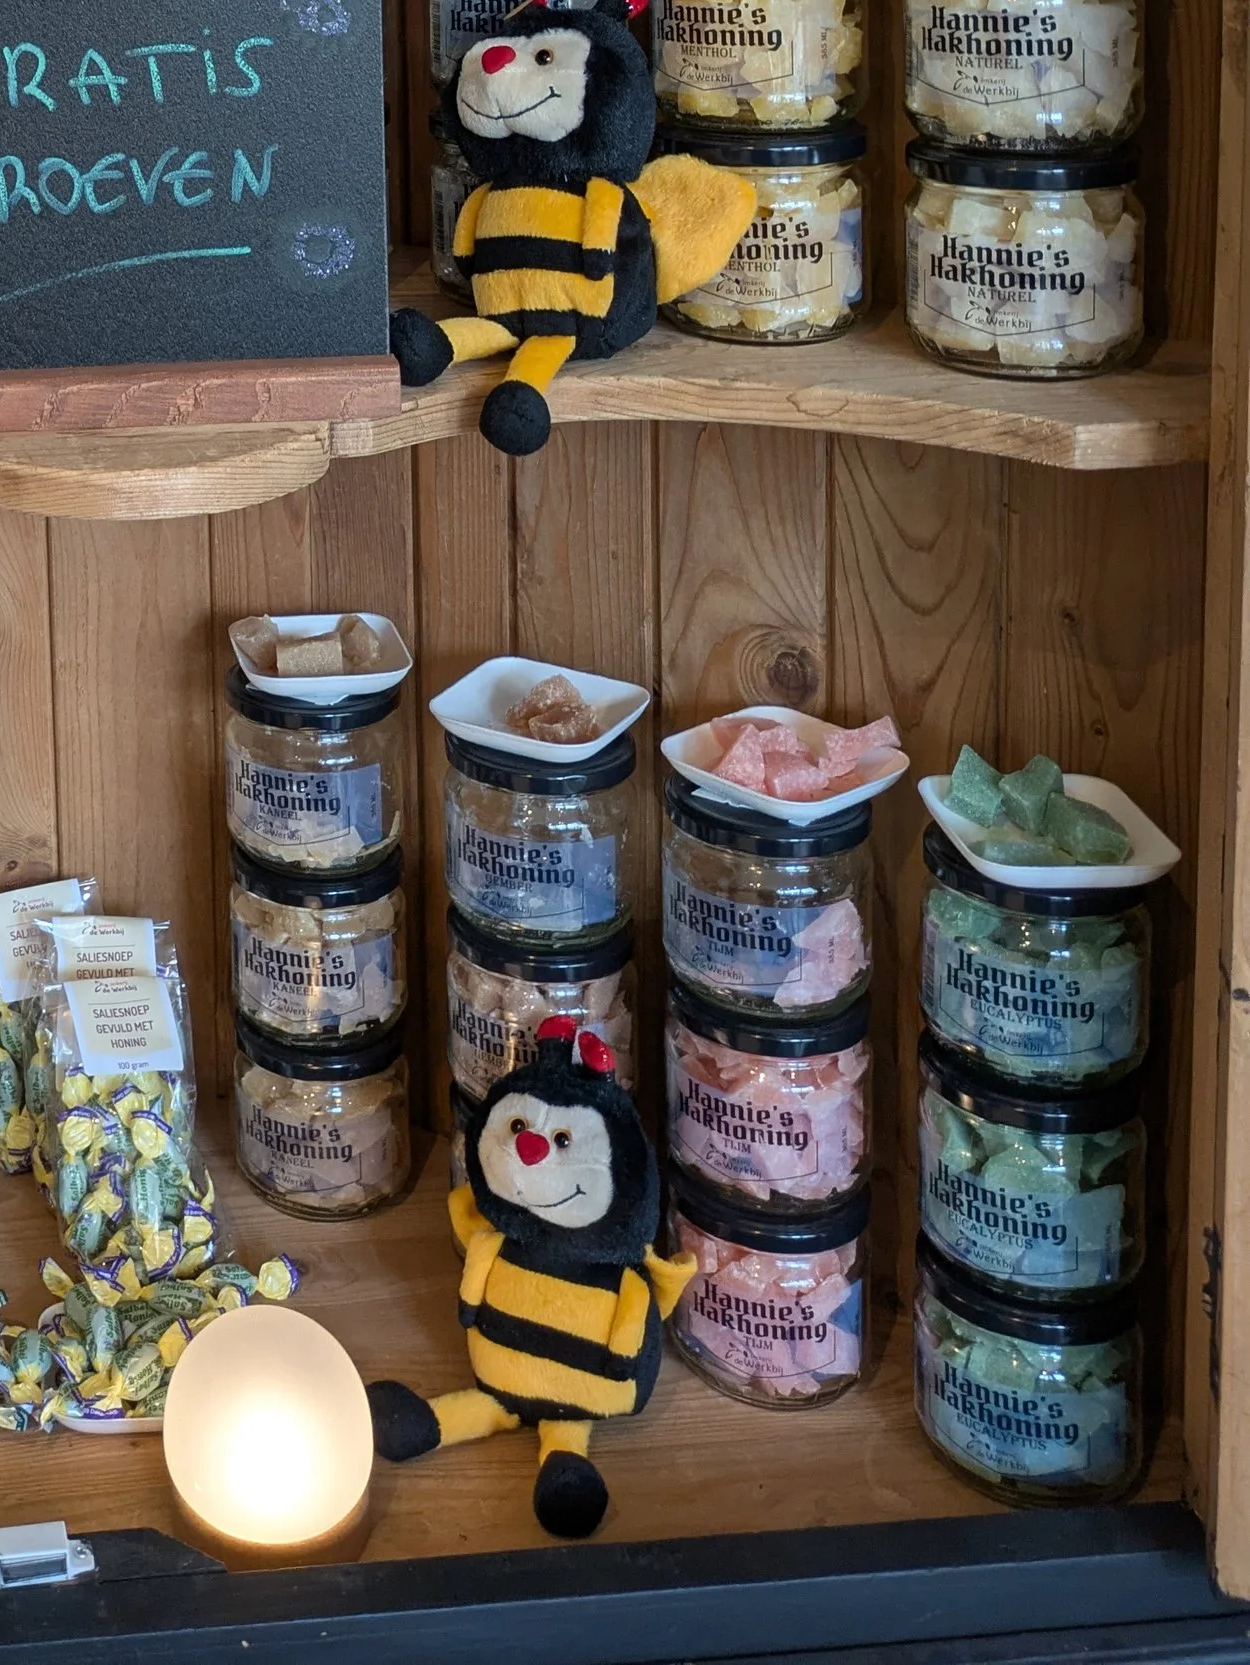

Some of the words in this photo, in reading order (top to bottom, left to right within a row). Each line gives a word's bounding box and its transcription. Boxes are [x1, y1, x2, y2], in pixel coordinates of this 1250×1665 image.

[656, 17, 783, 52] Hakhoning
[930, 4, 1058, 34] Hannie's
[680, 44, 737, 59] MENTHOL
[921, 26, 1074, 62] Hakhoning
[954, 55, 1024, 70] NATUREL
[941, 233, 1071, 269] Hannie's
[929, 253, 1086, 296] Hakhoning
[966, 286, 1037, 304] NATUREL
[465, 823, 563, 866] Hannie's
[457, 837, 575, 889] Hakhoning
[484, 873, 534, 893] GEMBER
[244, 949, 357, 990] Hakhoning
[251, 936, 344, 970] Hannie's
[272, 981, 318, 997] KANEEL
[957, 948, 1081, 998] Hannie's
[945, 962, 1095, 1024] Hakhoning
[92, 1004, 150, 1019] SALIESNOEP
[95, 1022, 133, 1035] GEVULD
[133, 1020, 154, 1032] MET
[969, 998, 1063, 1031] EUCALYPTUS
[110, 1037, 148, 1049] HONING
[693, 1290, 828, 1344] Hakhoning
[703, 1278, 815, 1322] Hannie's
[742, 1335, 774, 1352] TIJM
